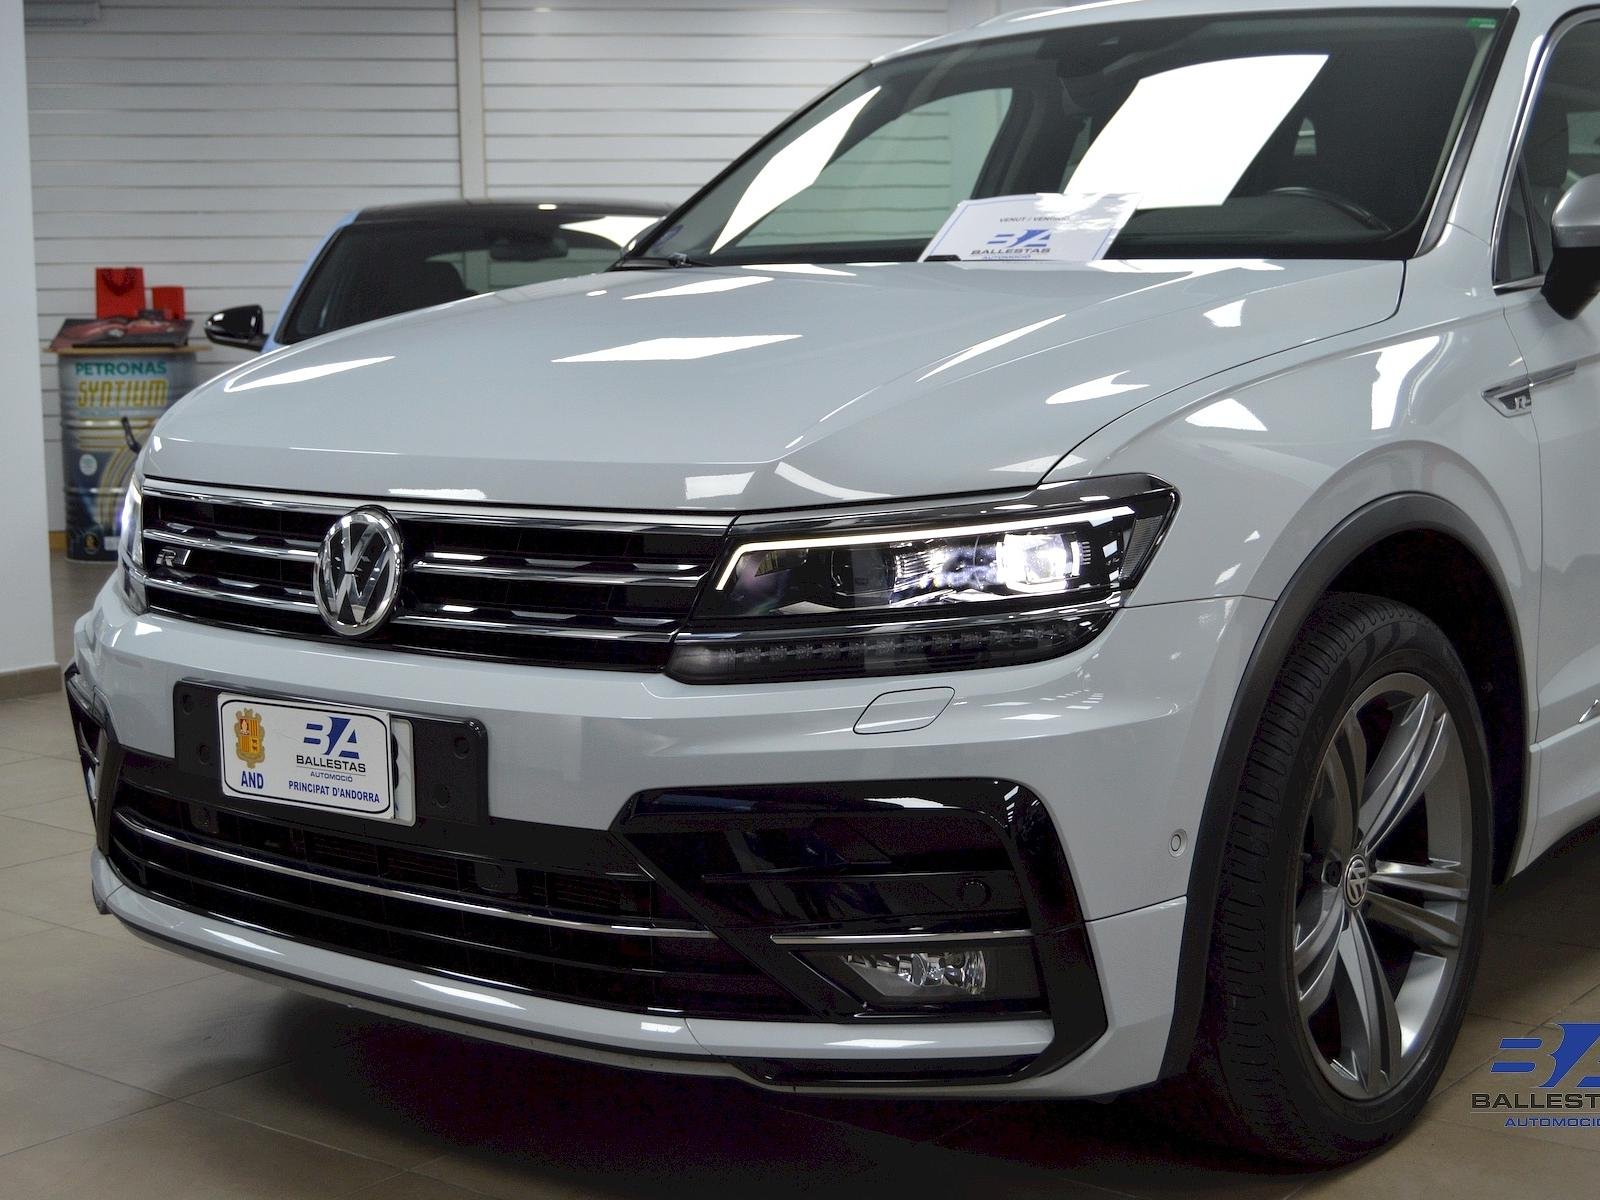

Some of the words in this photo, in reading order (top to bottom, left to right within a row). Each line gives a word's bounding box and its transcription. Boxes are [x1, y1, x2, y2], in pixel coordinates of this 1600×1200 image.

[970, 247, 1052, 255] BALLESTAS
[75, 362, 168, 375] PETRONAS
[77, 379, 168, 408] SYNTIUM
[296, 755, 366, 773] BALLESTAS
[240, 770, 264, 790] AND
[288, 780, 330, 796] PRINCIPAT
[332, 787, 380, 804] D'ANDORRA
